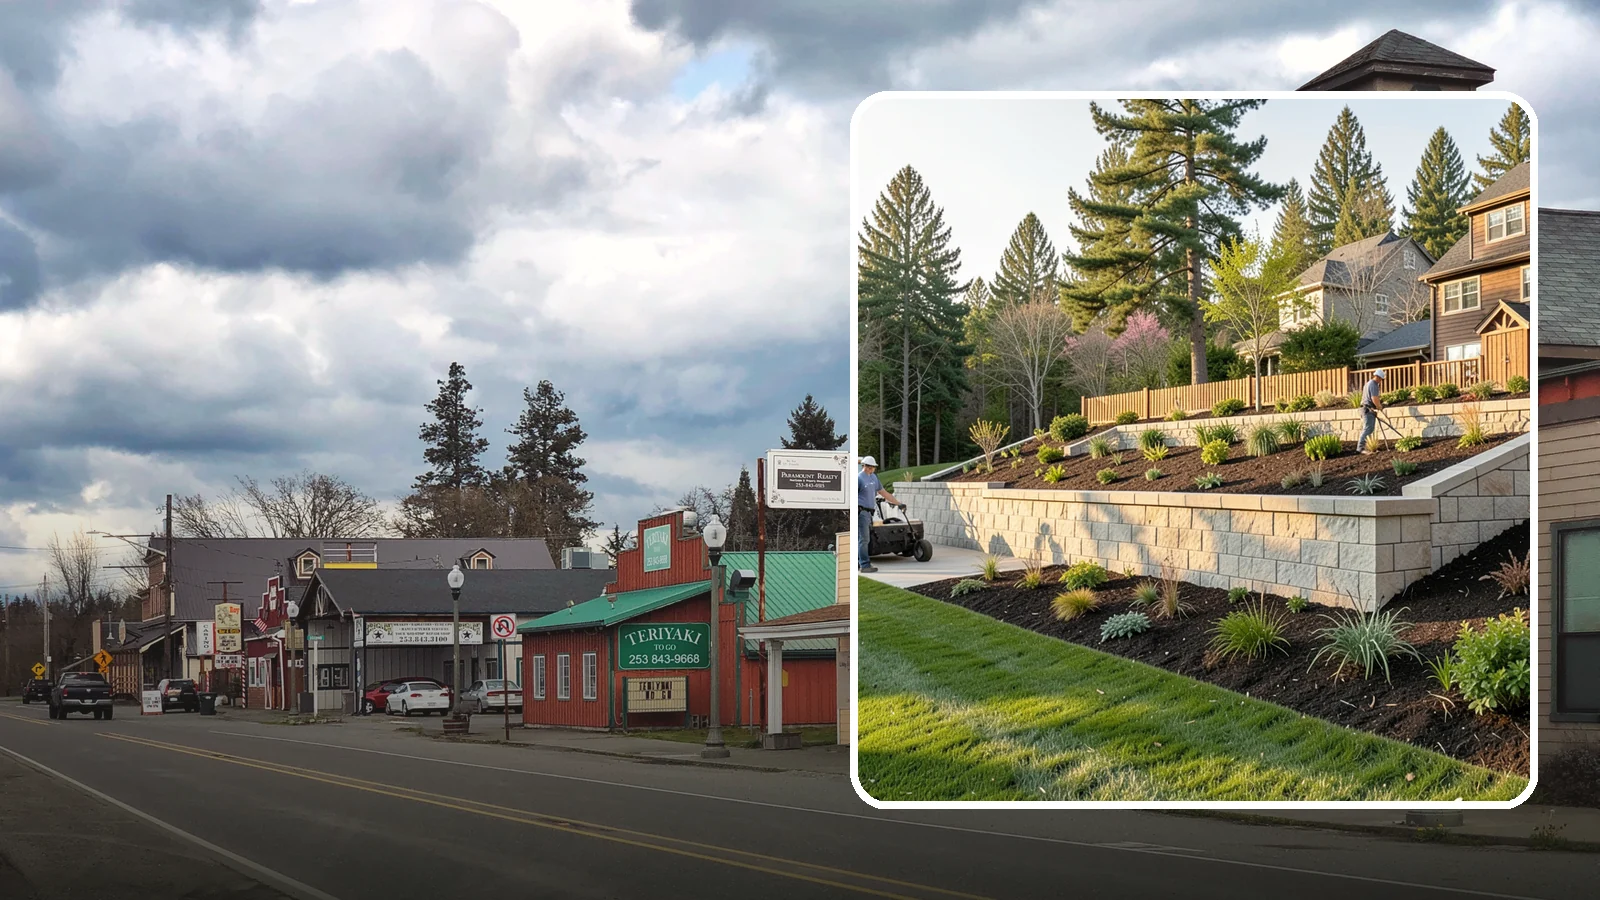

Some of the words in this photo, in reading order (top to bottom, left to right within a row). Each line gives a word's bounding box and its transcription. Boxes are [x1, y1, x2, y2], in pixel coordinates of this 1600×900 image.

[781, 471, 815, 479] PARAMOUNT
[817, 472, 839, 480] REALTY
[625, 627, 702, 646] TERIYAKI
[665, 643, 677, 651] GO
[629, 654, 649, 665] 253
[651, 653, 700, 664] 843-9668
